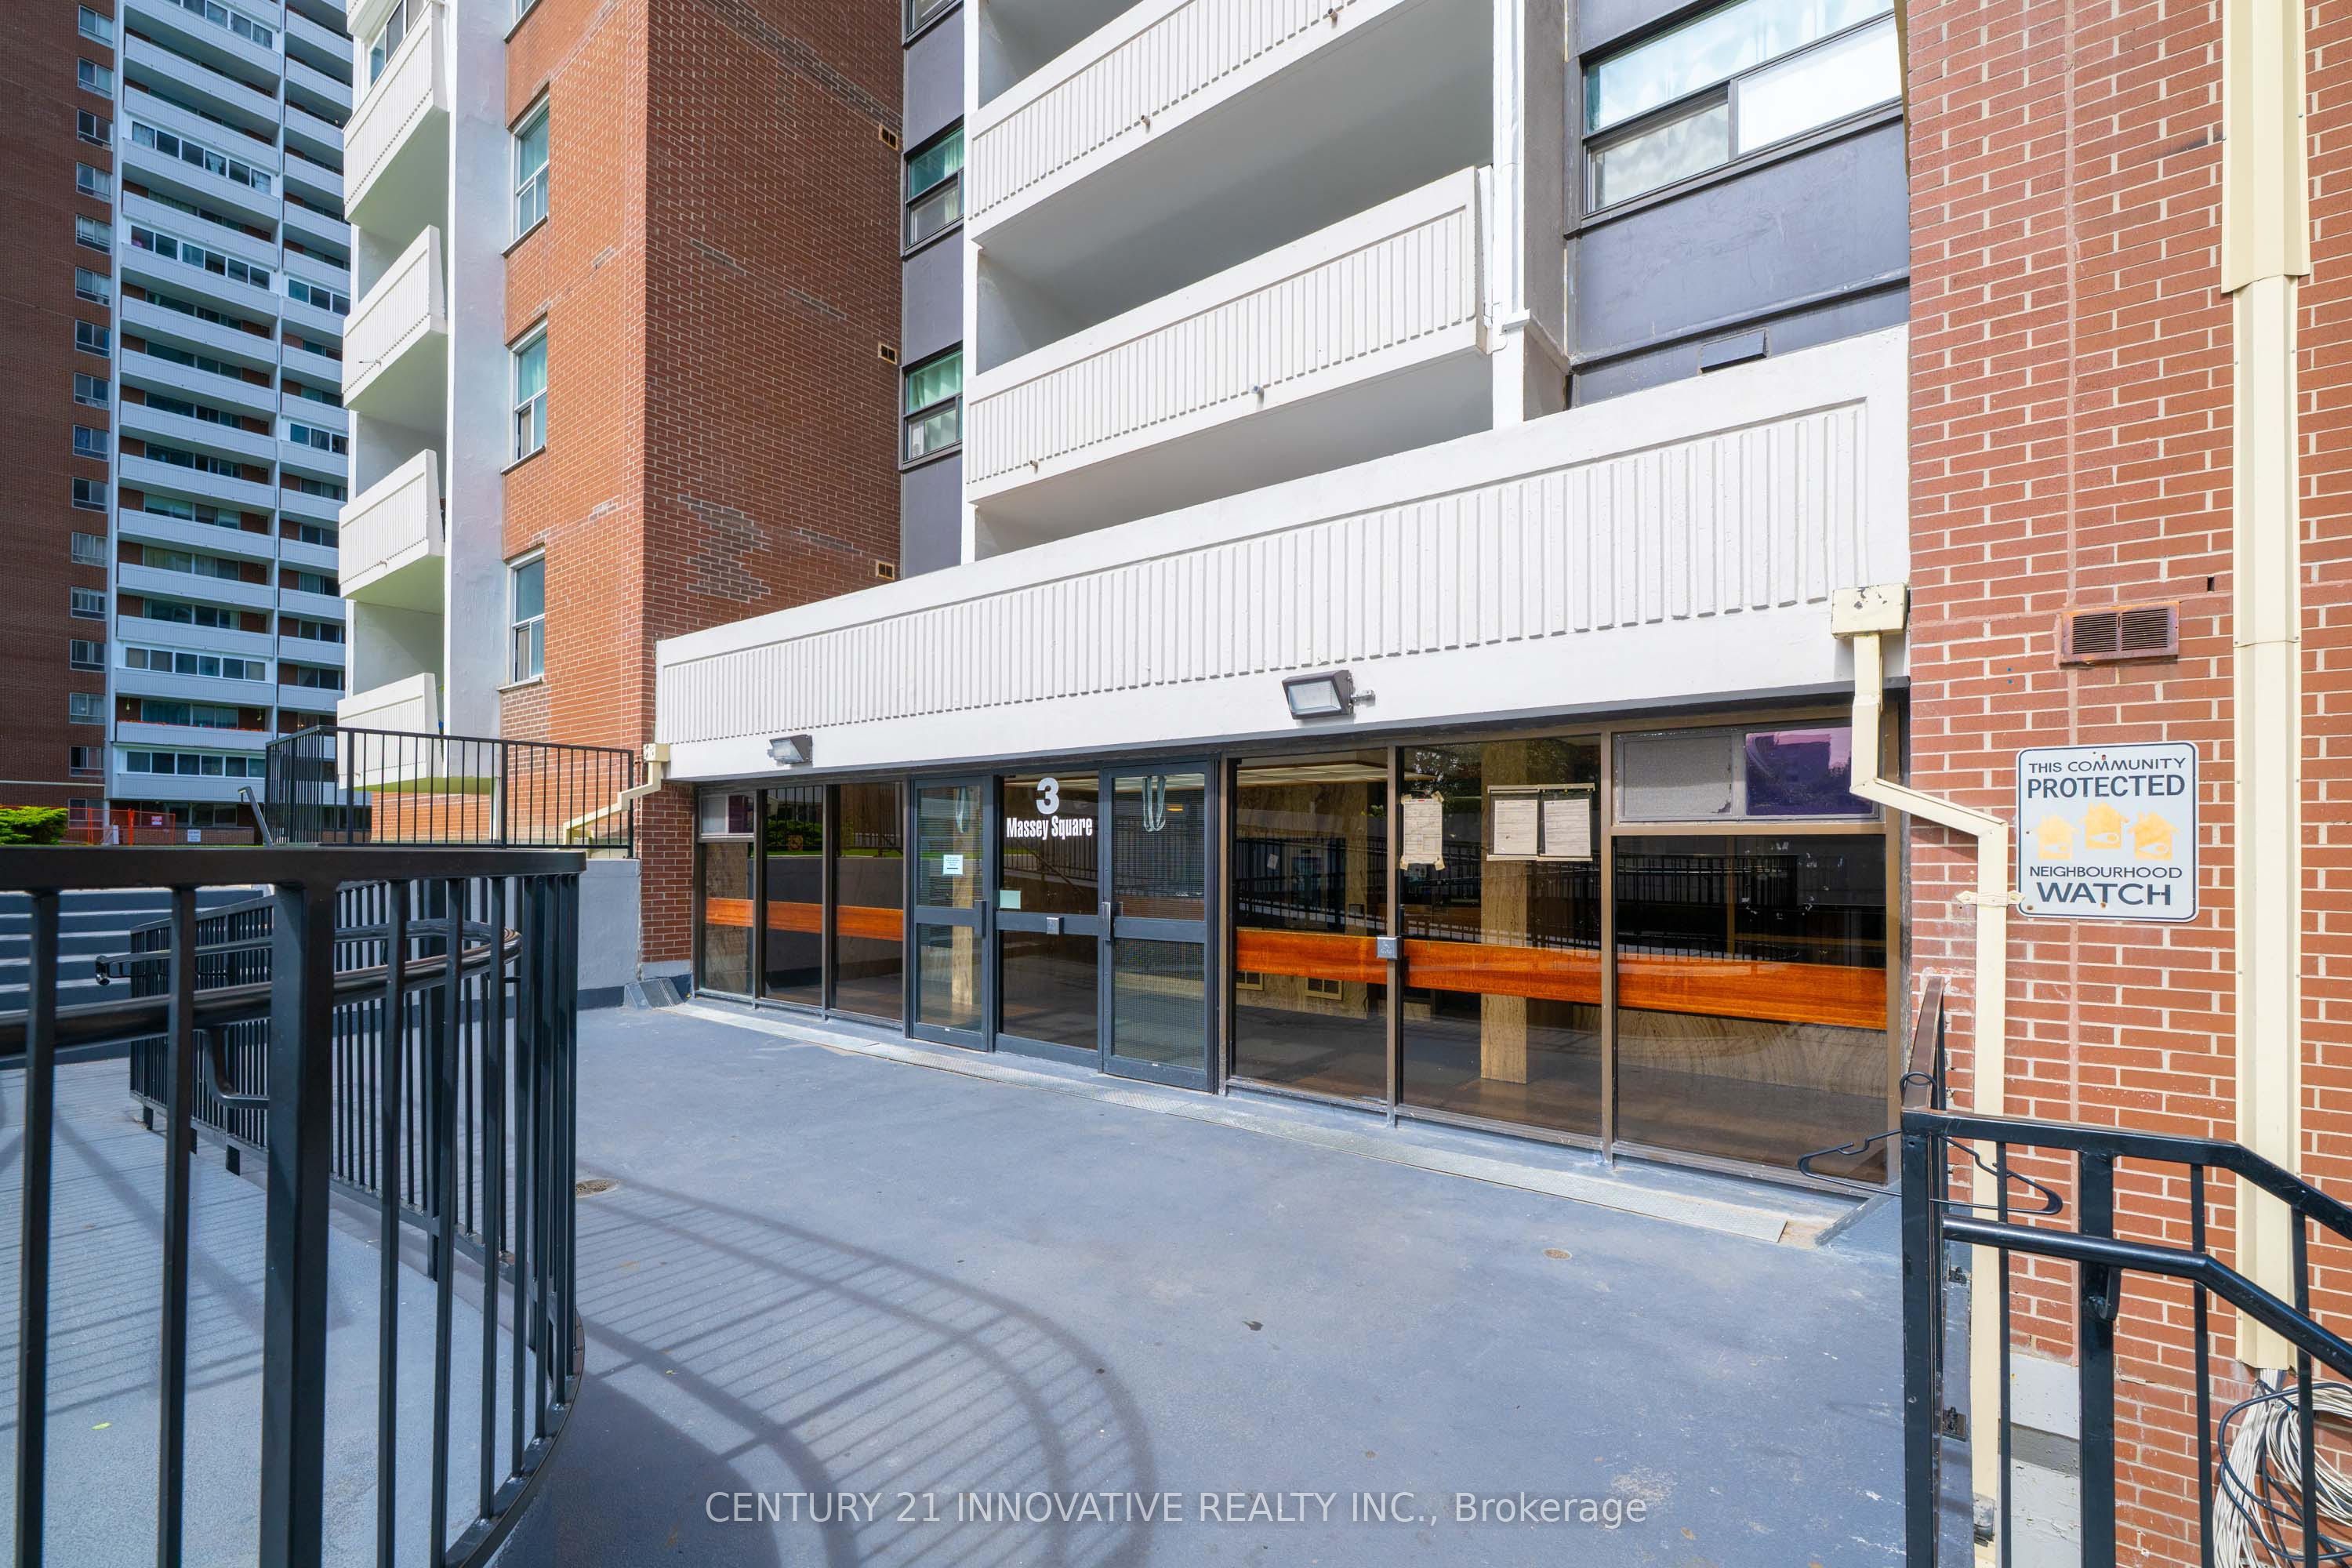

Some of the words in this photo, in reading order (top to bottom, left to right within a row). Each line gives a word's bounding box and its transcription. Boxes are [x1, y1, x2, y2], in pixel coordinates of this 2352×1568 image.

[2029, 762, 2062, 774] THIS
[2067, 757, 2186, 772] COMMUNITY
[1036, 777, 1060, 815] 3
[2027, 775, 2185, 798] PROTECTED
[1006, 817, 1049, 840] Massey
[1051, 815, 1093, 840] Square
[2029, 866, 2183, 879] NEIGHBOURHOOD
[2036, 882, 2171, 906] WATCH
